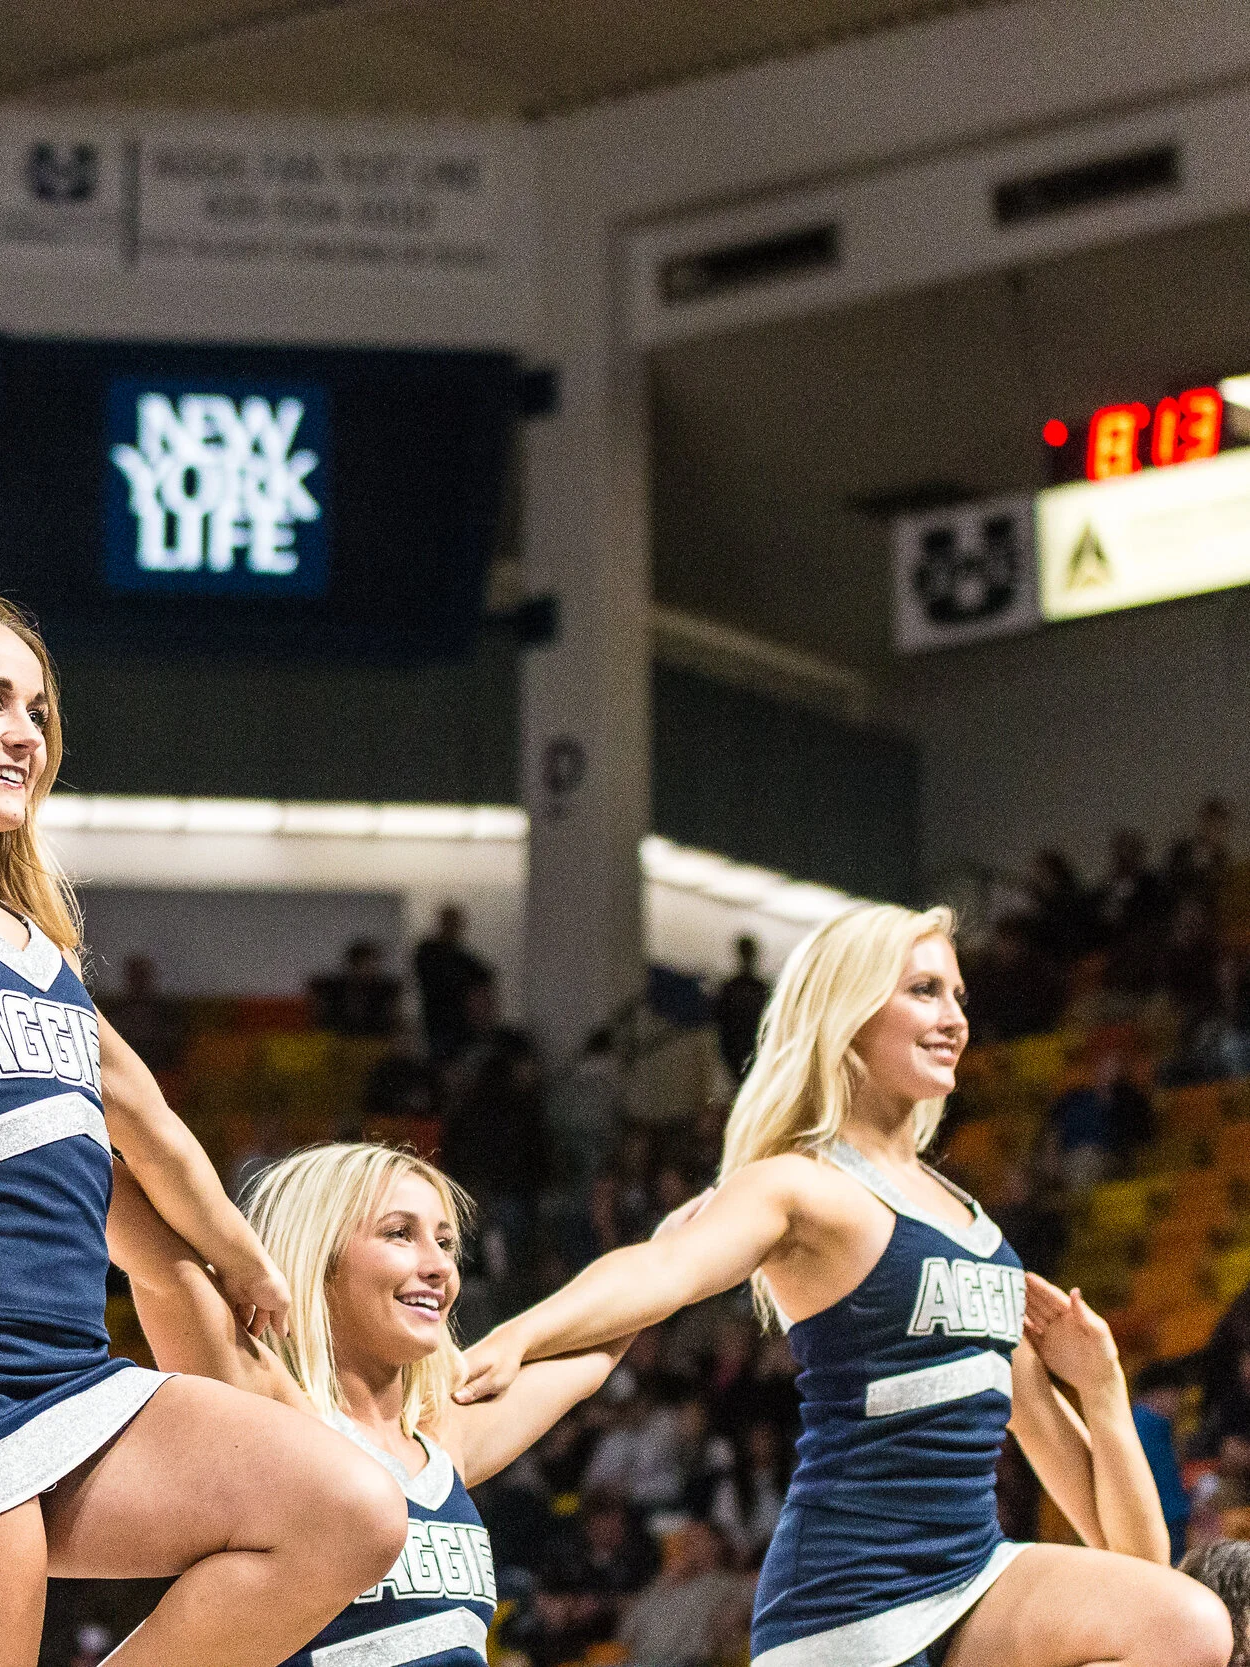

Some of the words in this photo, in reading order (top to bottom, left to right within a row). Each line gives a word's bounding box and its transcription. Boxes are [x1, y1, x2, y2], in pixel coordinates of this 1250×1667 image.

[136, 392, 305, 454] NEW
[109, 443, 322, 522] YORK
[136, 510, 300, 575] LIFE
